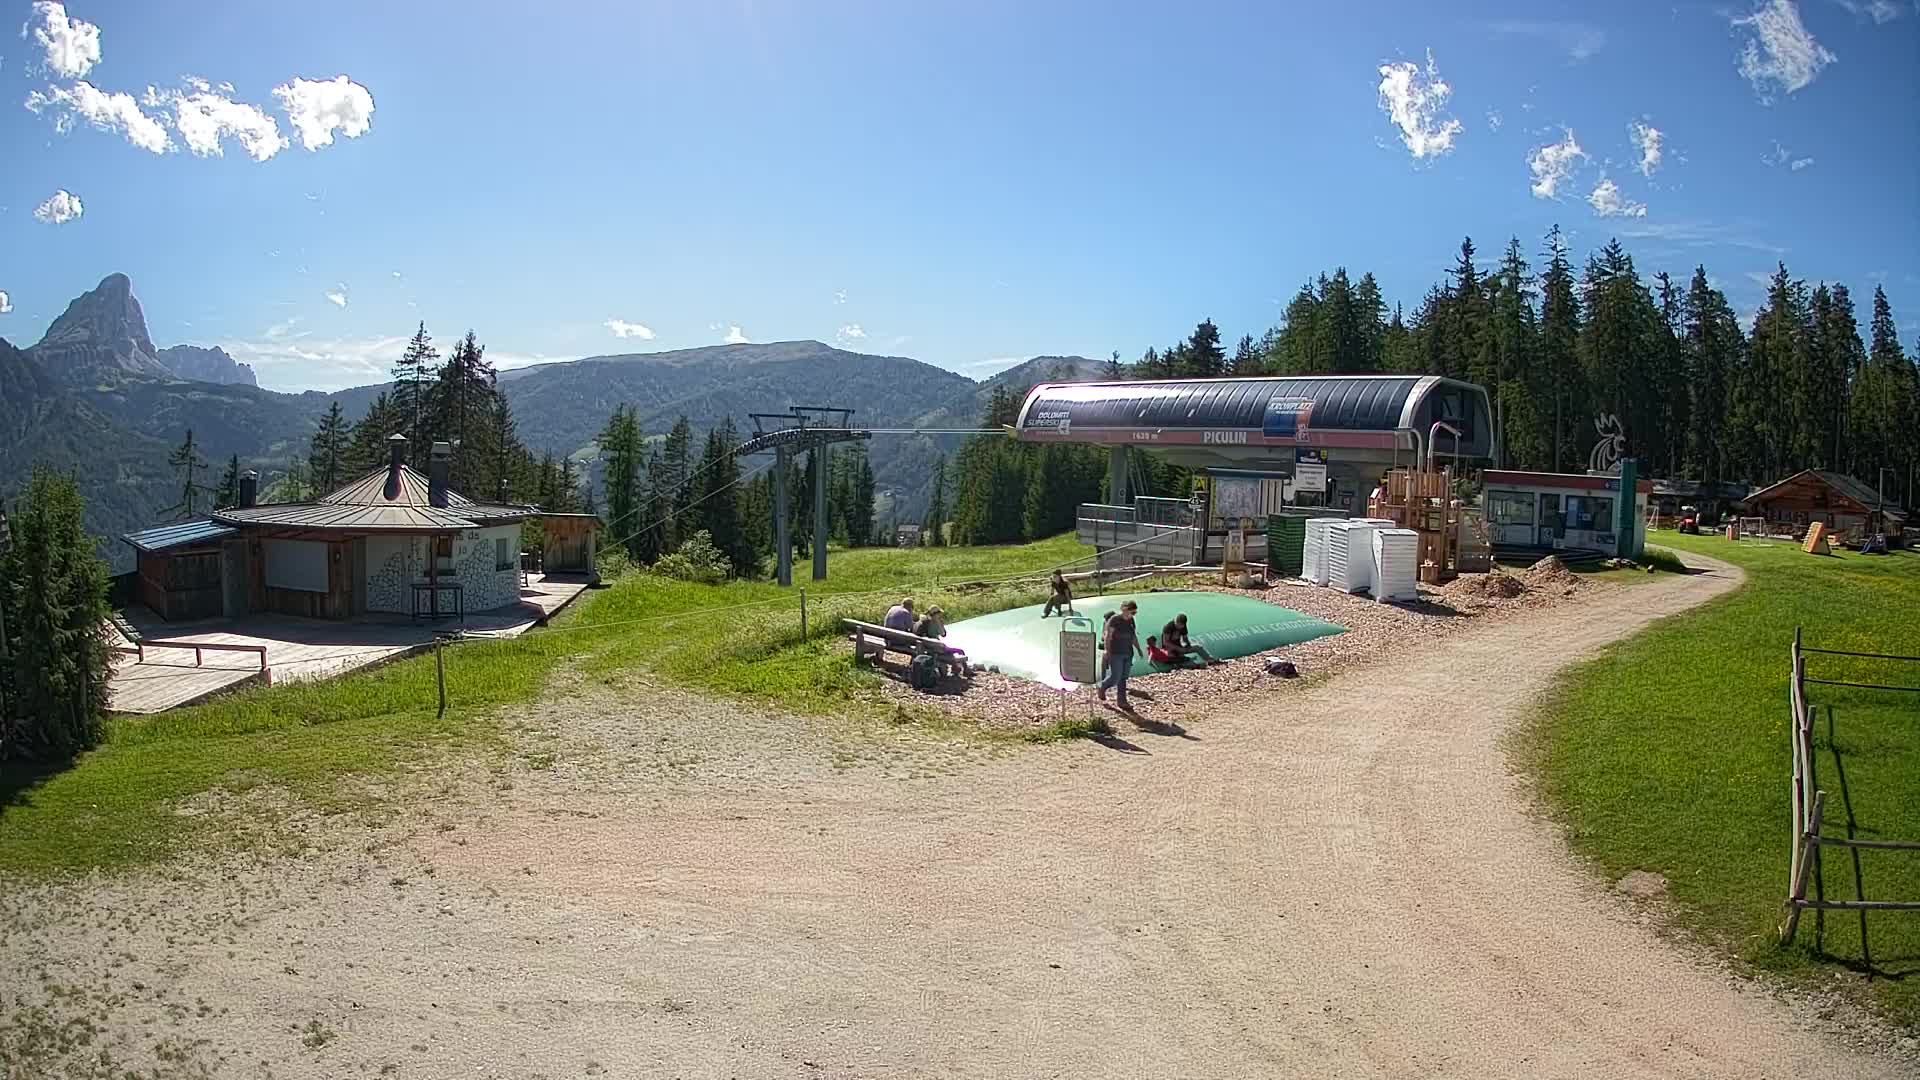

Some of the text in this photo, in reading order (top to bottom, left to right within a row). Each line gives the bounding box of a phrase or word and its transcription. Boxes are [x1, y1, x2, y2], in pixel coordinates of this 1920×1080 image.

[1038, 411, 1070, 419] DOLOMITI
[1027, 419, 1060, 427] SUPERSKI
[1203, 431, 1247, 444] PICULIN
[1206, 630, 1236, 641] MIND
